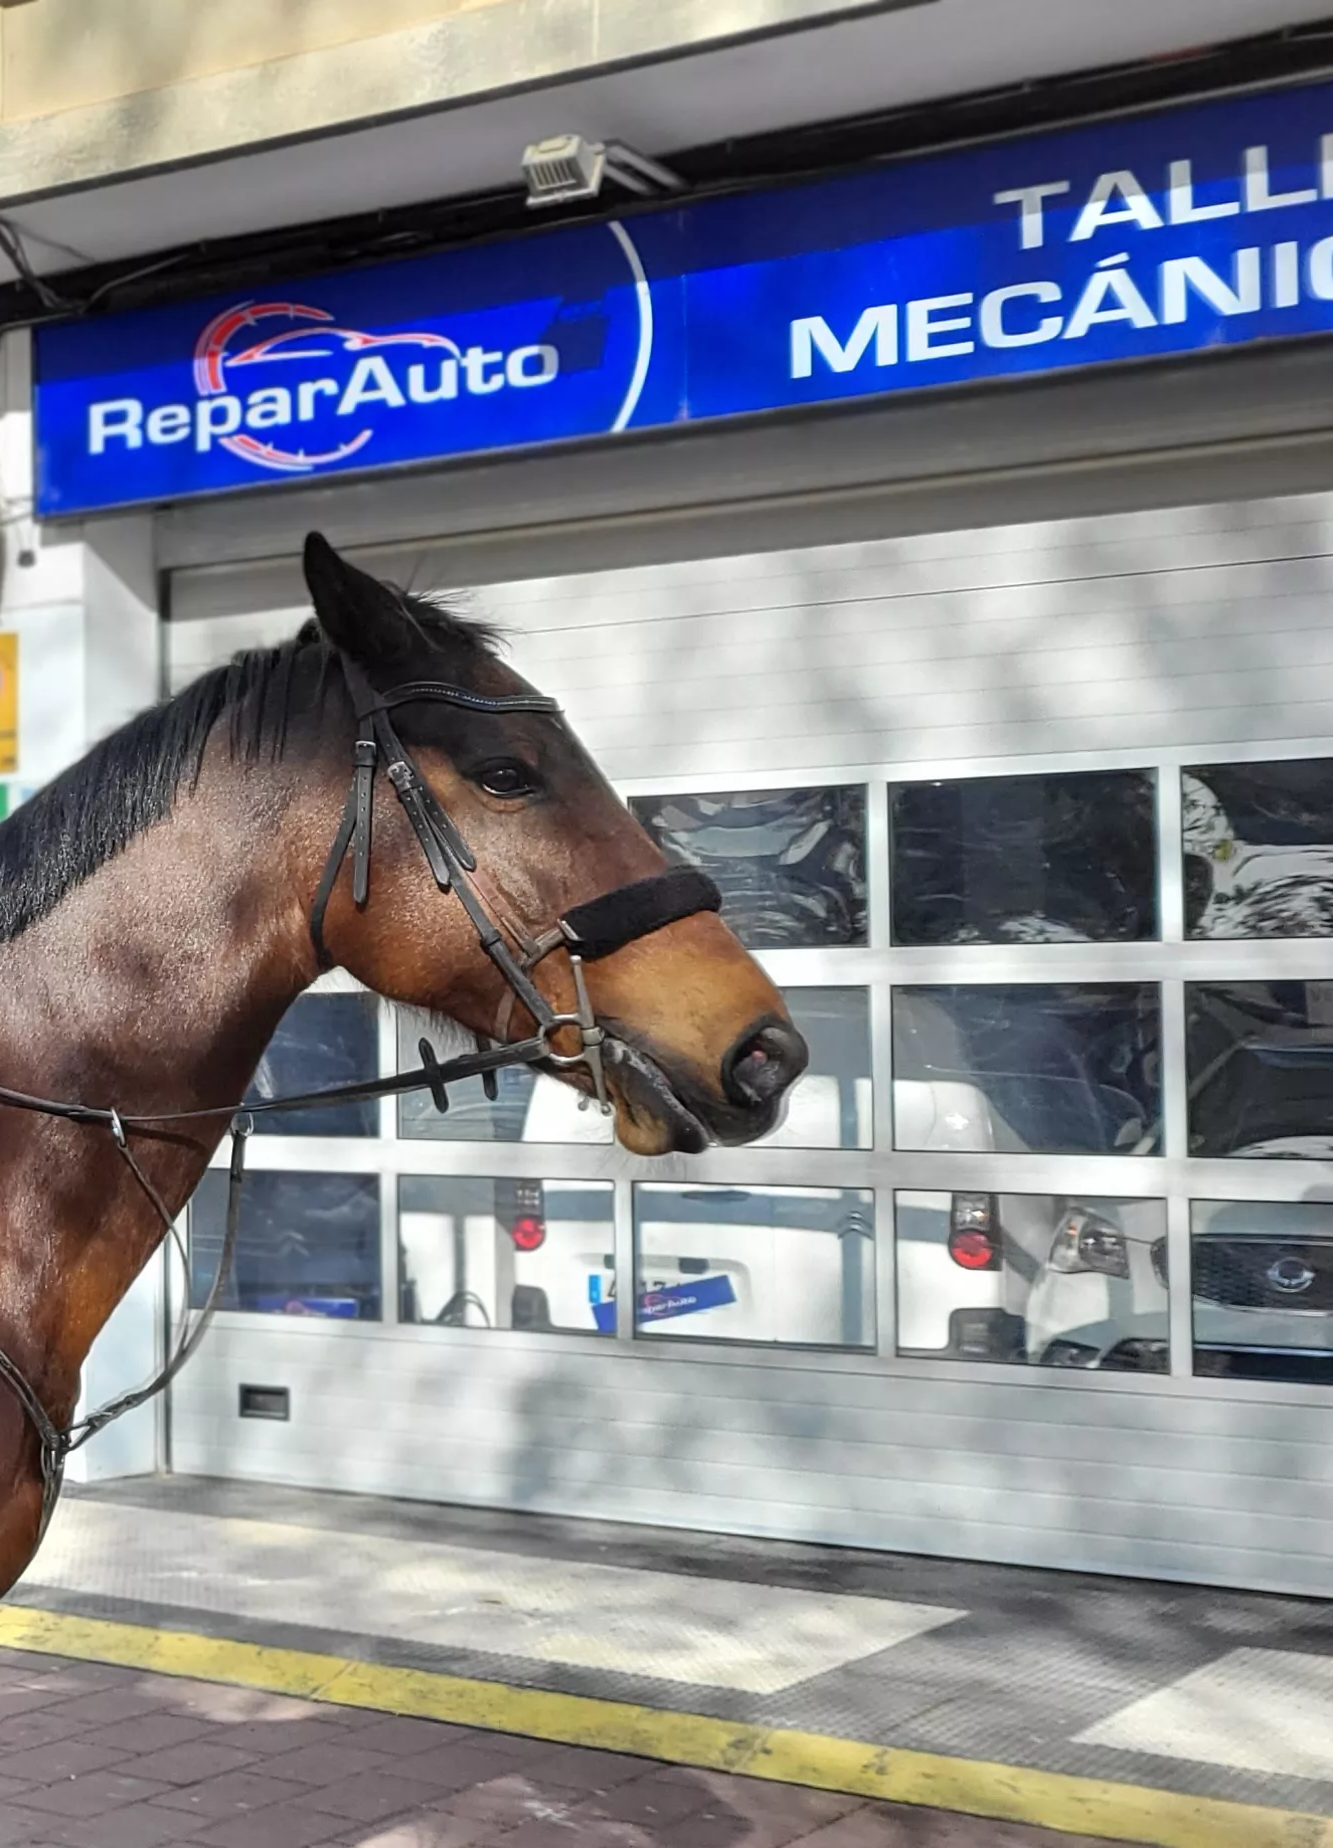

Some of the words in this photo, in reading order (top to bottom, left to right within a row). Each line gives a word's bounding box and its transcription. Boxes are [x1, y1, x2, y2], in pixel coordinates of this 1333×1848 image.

[993, 132, 1333, 251] TALL
[789, 236, 1333, 379] MECÁNI
[88, 343, 560, 455] ReparAuto
